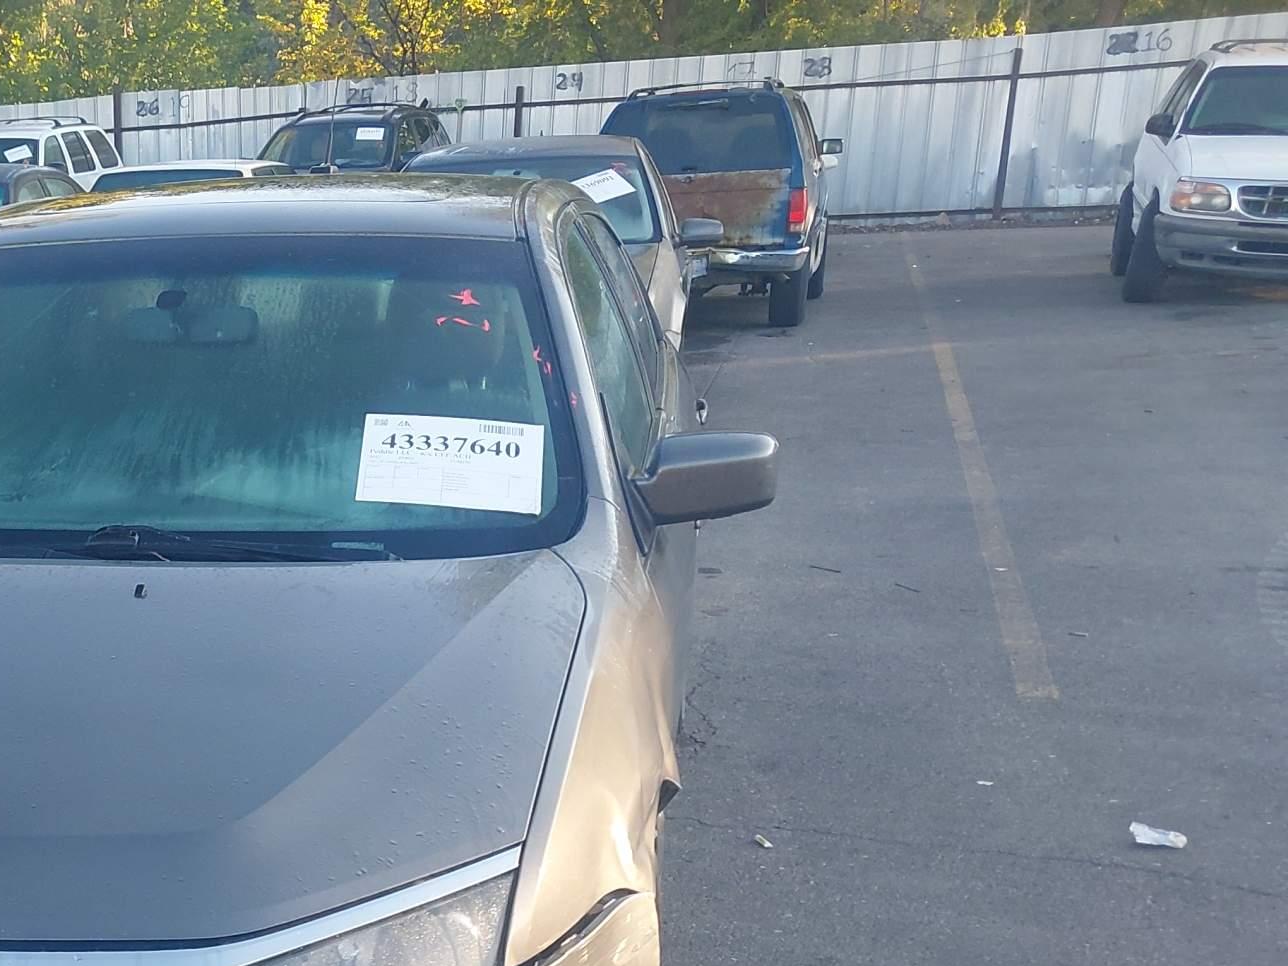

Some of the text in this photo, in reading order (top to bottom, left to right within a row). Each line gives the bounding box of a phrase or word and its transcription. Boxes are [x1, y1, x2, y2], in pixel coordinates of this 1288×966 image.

[1141, 28, 1173, 52] 16
[170, 94, 190, 119] 19
[381, 432, 521, 459] 43337640
